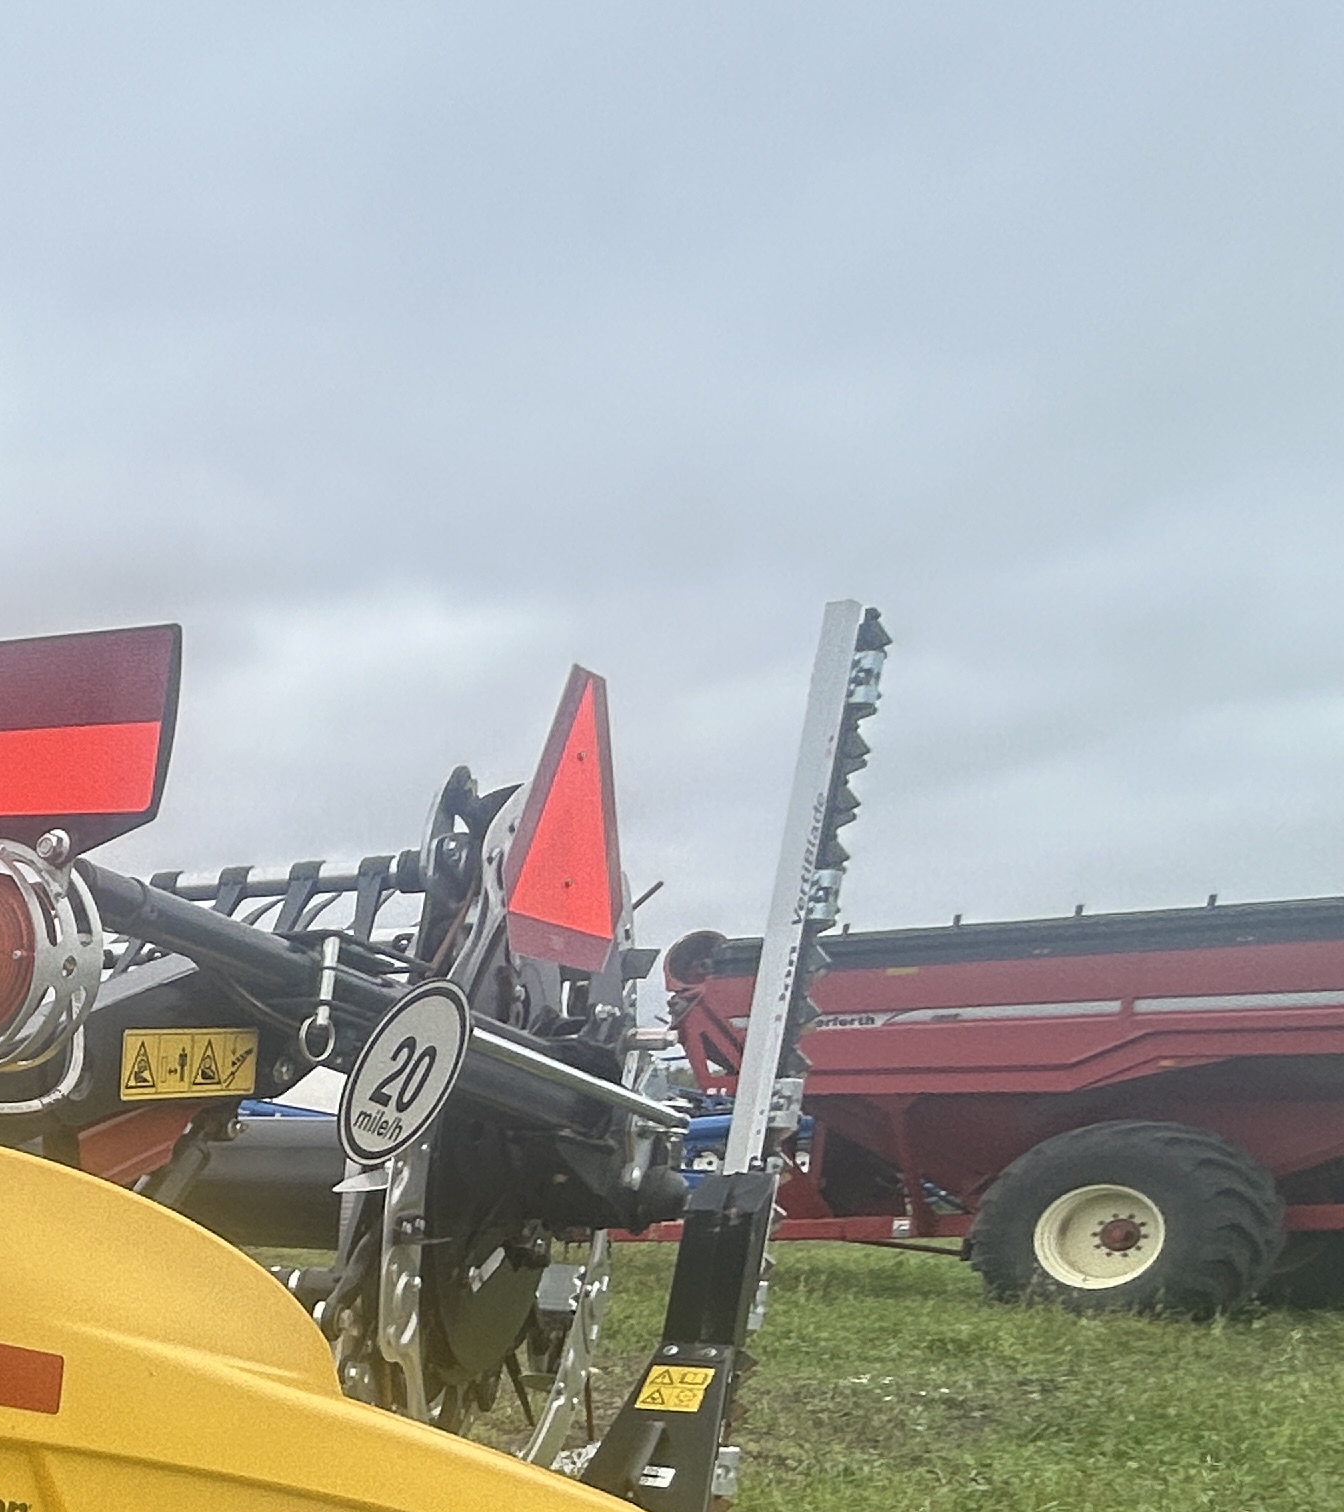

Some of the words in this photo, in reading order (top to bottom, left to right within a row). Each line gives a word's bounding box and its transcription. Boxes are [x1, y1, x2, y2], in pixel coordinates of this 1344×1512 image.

[815, 1014, 875, 1027] erferth
[368, 1036, 437, 1113] 20
[353, 1110, 404, 1142] mile/h
